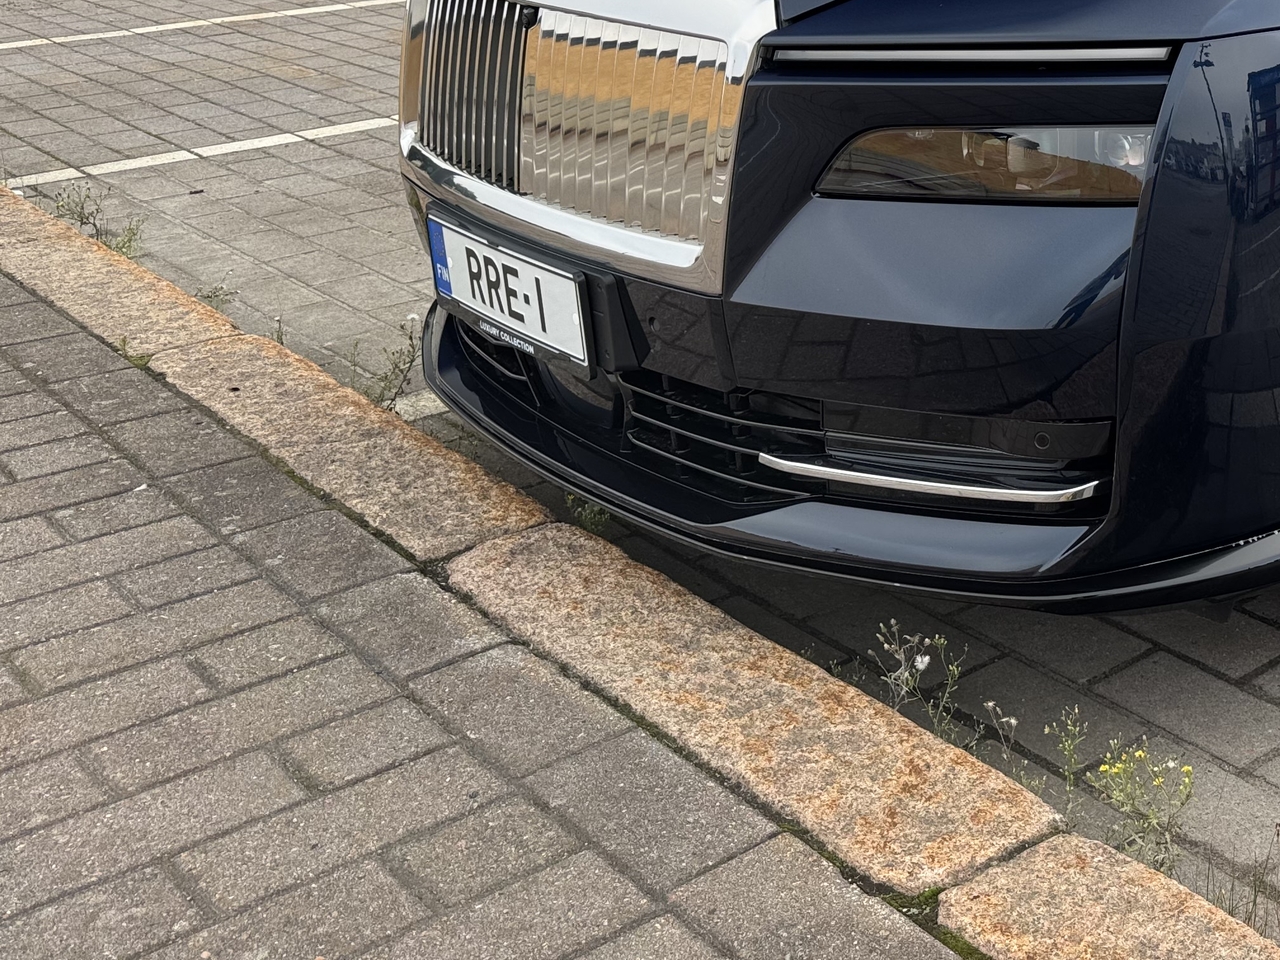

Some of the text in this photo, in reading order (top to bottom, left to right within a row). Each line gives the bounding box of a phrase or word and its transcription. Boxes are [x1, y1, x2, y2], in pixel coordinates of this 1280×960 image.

[436, 263, 450, 283] FIN
[479, 320, 535, 354] LUXURY COLLECTION
